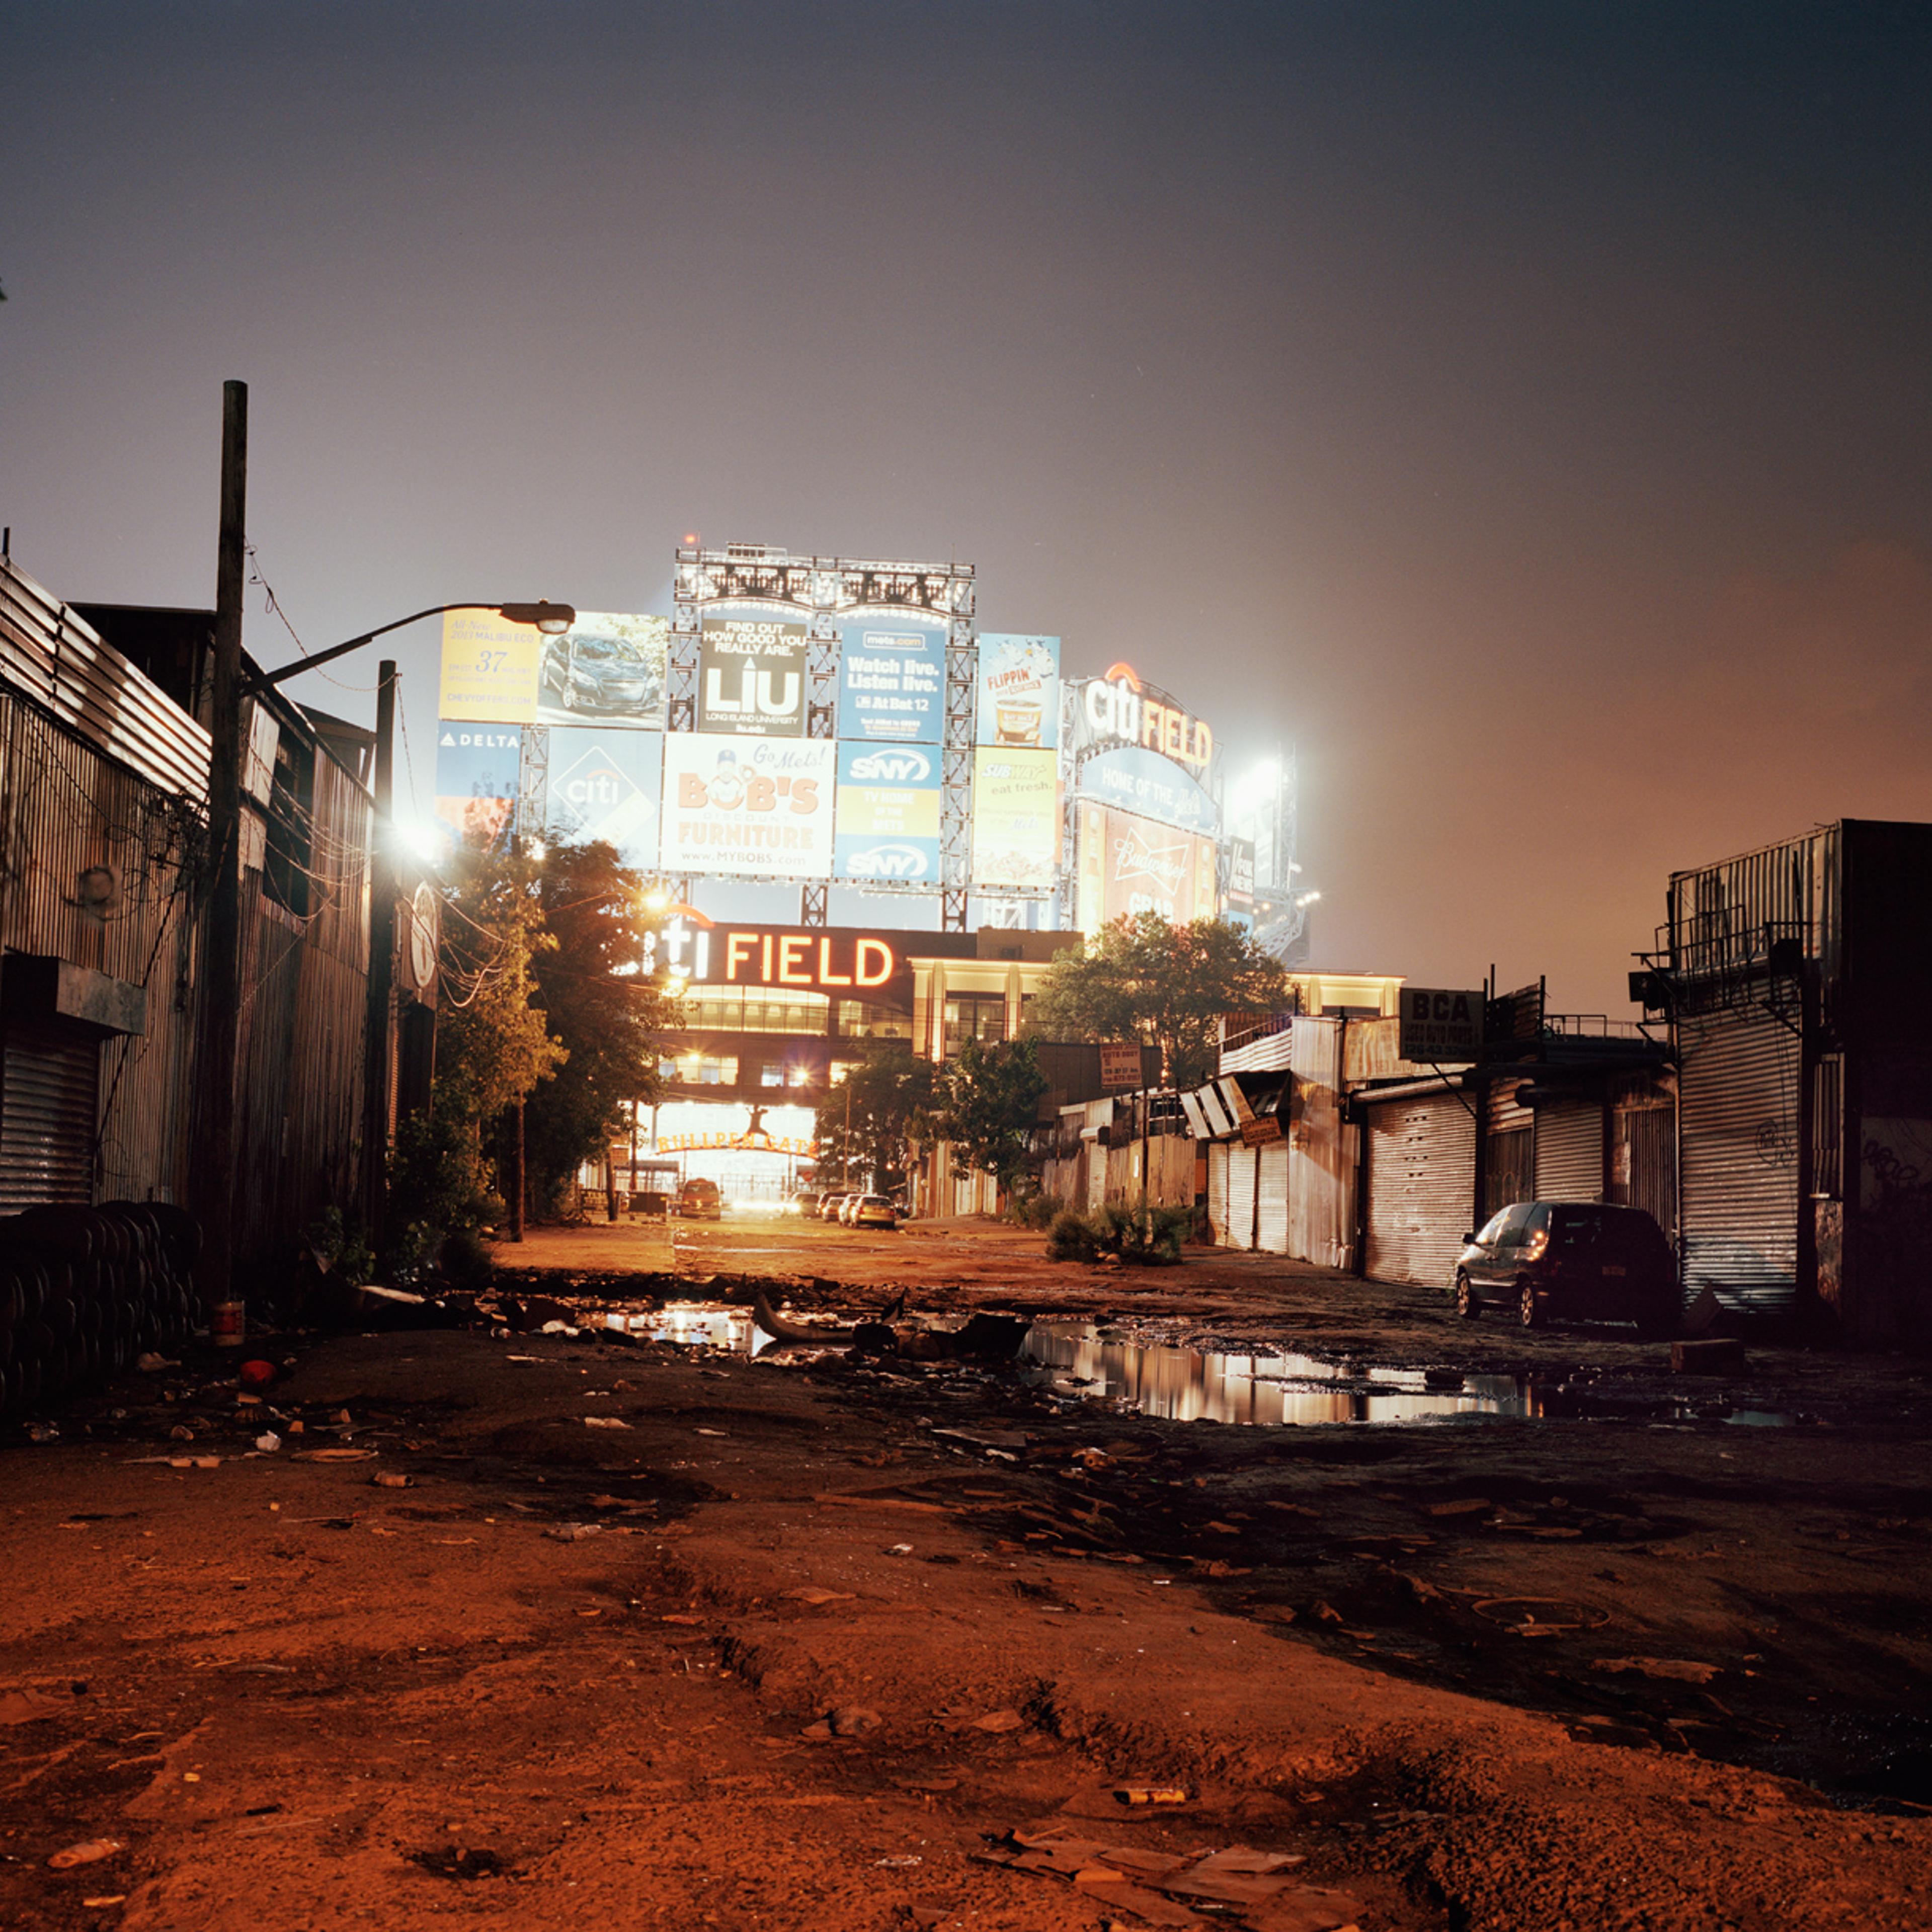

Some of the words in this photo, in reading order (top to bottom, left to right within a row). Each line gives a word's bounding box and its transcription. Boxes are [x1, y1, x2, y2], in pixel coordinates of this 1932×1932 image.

[475, 631, 512, 642] MALIBU
[514, 633, 534, 643] ECO
[726, 622, 754, 632] FIND
[758, 623, 785, 634] OUT
[703, 630, 735, 642] HOW
[737, 633, 776, 644] GOOD
[779, 636, 807, 646] YOU
[867, 636, 921, 646] mets.com
[715, 642, 761, 654] REALLY
[764, 646, 793, 656] ARE.
[475, 650, 509, 674] 37
[847, 656, 901, 674] Watch
[904, 659, 939, 676] live.
[847, 673, 899, 689] Listen
[903, 675, 938, 692] live.
[987, 666, 1031, 690] FLIPPIN'
[447, 692, 531, 705] CHEVYOFFERS.COM
[706, 665, 800, 715] LIU
[872, 696, 889, 709] At
[890, 697, 914, 711] Bat
[915, 699, 929, 712] 12
[706, 713, 727, 722] LONG
[730, 713, 754, 723] ISLAND
[757, 715, 798, 725] UNIVERSITY
[460, 734, 519, 748] DELTA
[1143, 699, 1212, 767] FIELD
[753, 744, 775, 764] Go
[774, 746, 827, 768] Mets!
[850, 754, 925, 780] SNY
[981, 763, 1047, 779] SUBWAY
[679, 773, 819, 815] BOB'S
[991, 785, 1012, 795] eat
[1015, 781, 1053, 793] fresh.
[1102, 766, 1135, 794] HOME
[1136, 778, 1152, 796] OF
[1153, 783, 1173, 805] THE
[864, 791, 878, 803] TV
[881, 791, 914, 804] HOME
[703, 812, 789, 823] DISCOUNT
[678, 822, 814, 849] FURNITURE
[682, 851, 806, 865] www.MYBOBS.com
[846, 849, 922, 876] SNY
[1114, 839, 1187, 878] Budweiser
[727, 932, 894, 987] FIELD
[1413, 993, 1470, 1021] BCA
[657, 1132, 755, 1152] BULLPEN
[765, 1135, 819, 1157] GATE
